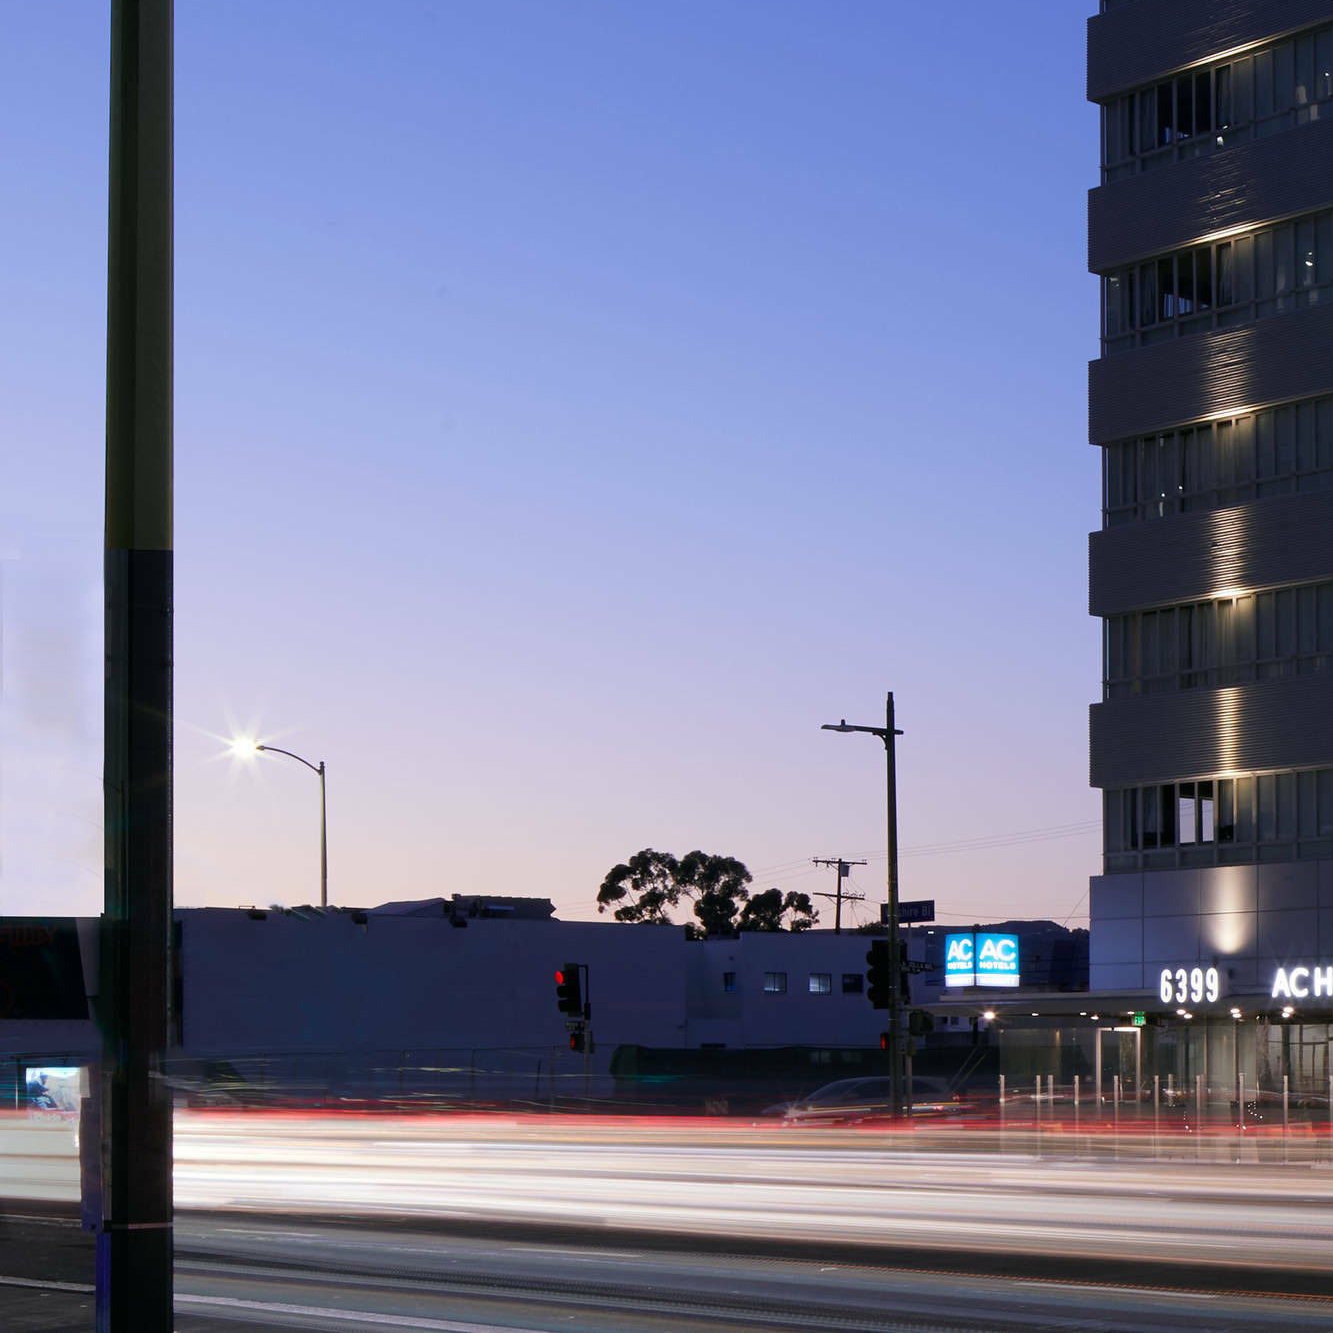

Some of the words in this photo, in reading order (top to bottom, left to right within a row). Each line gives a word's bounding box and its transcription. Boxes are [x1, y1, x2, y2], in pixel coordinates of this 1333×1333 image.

[947, 938, 972, 961] AC
[979, 939, 1016, 961] AC
[979, 962, 1016, 970] HOTELS
[1160, 967, 1219, 1003] 6399
[1271, 967, 1310, 998] AC
